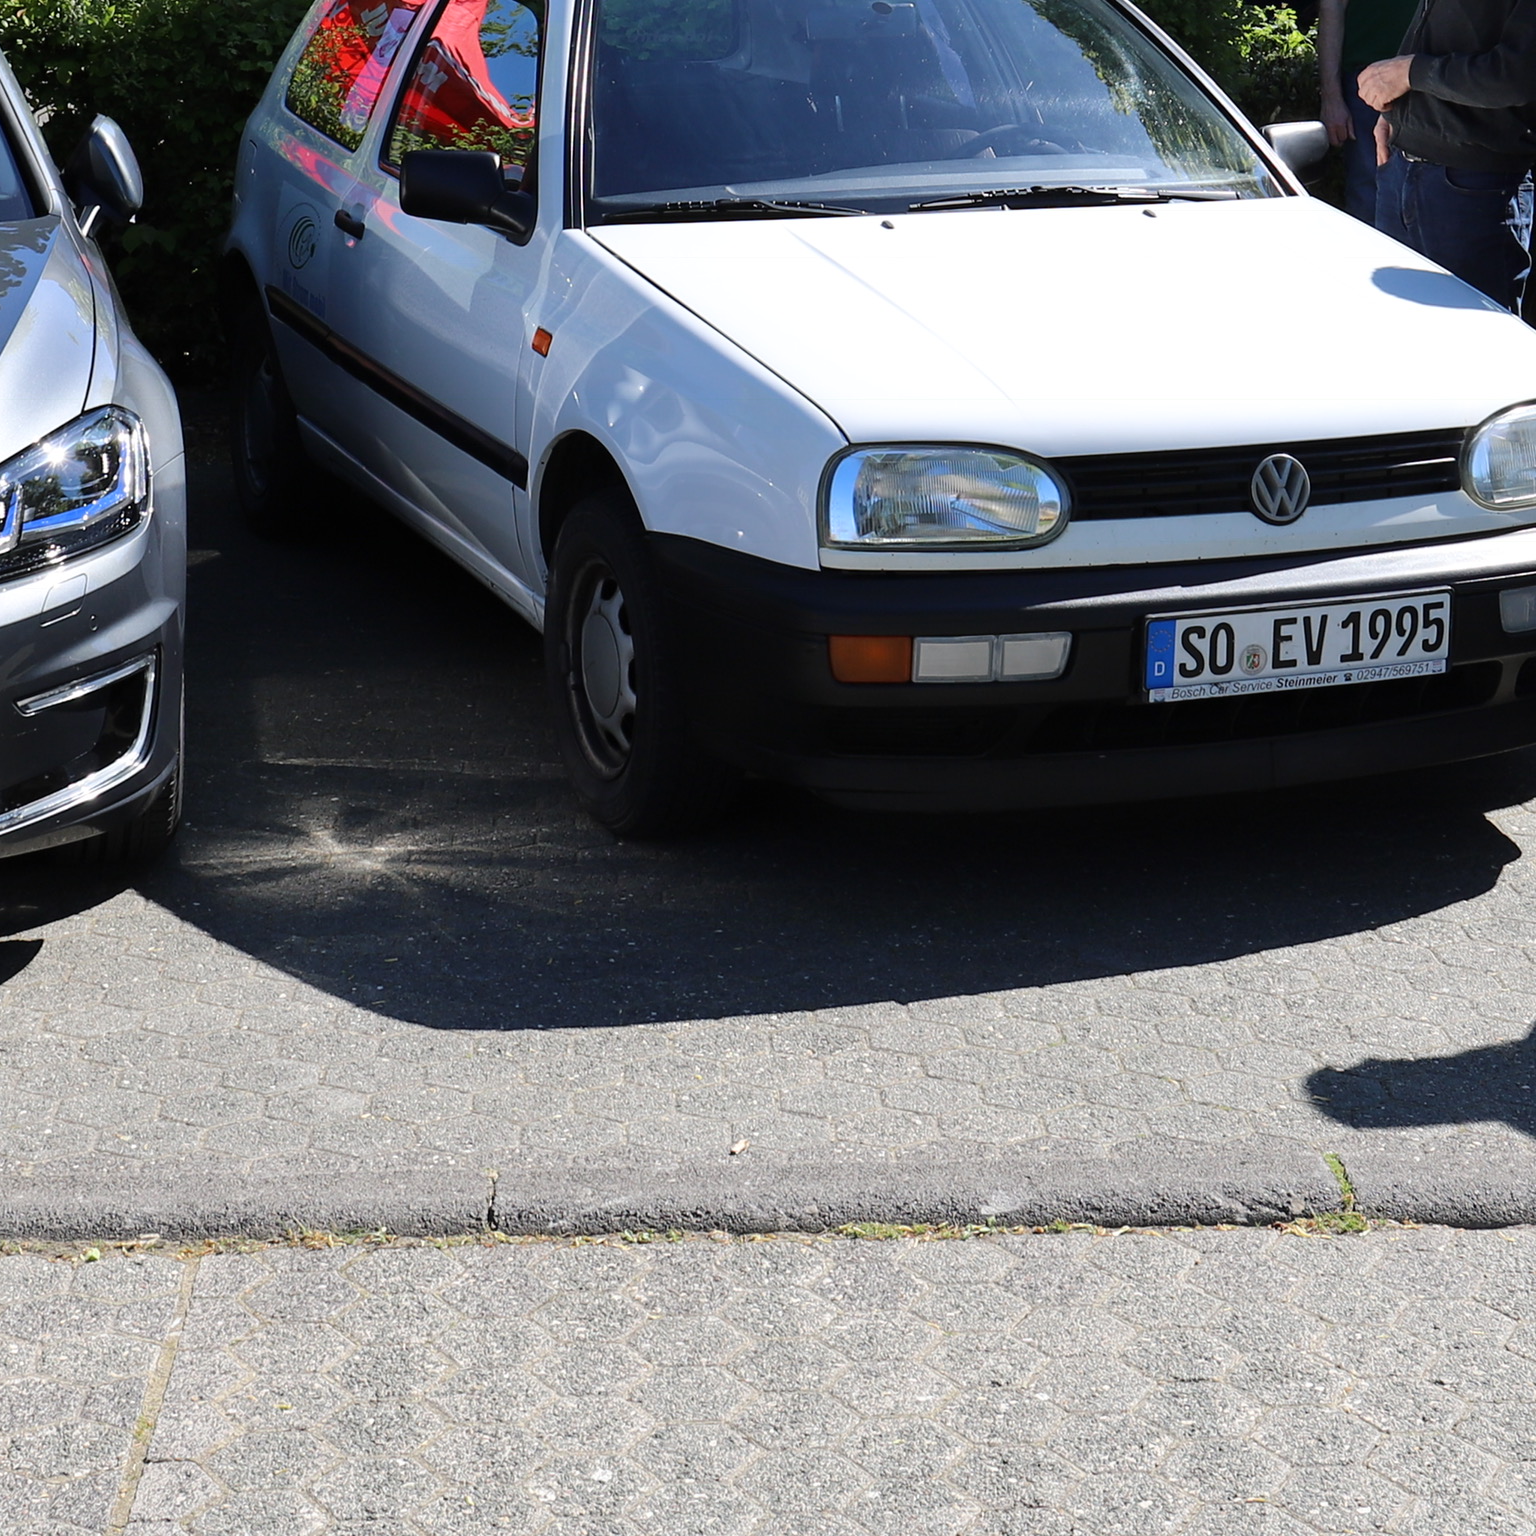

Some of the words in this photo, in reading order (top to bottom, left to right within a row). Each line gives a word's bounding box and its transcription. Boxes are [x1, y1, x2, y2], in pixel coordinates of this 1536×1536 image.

[1178, 622, 1235, 679] SO
[1271, 614, 1328, 670] EV
[1340, 601, 1445, 663] 1995
[1154, 661, 1166, 677] D
[1171, 687, 1206, 700] Bosch
[1209, 684, 1229, 696] Car
[1232, 680, 1273, 694] Service
[1276, 673, 1338, 689] Steinmeier
[1357, 663, 1430, 681] 02947/569751
